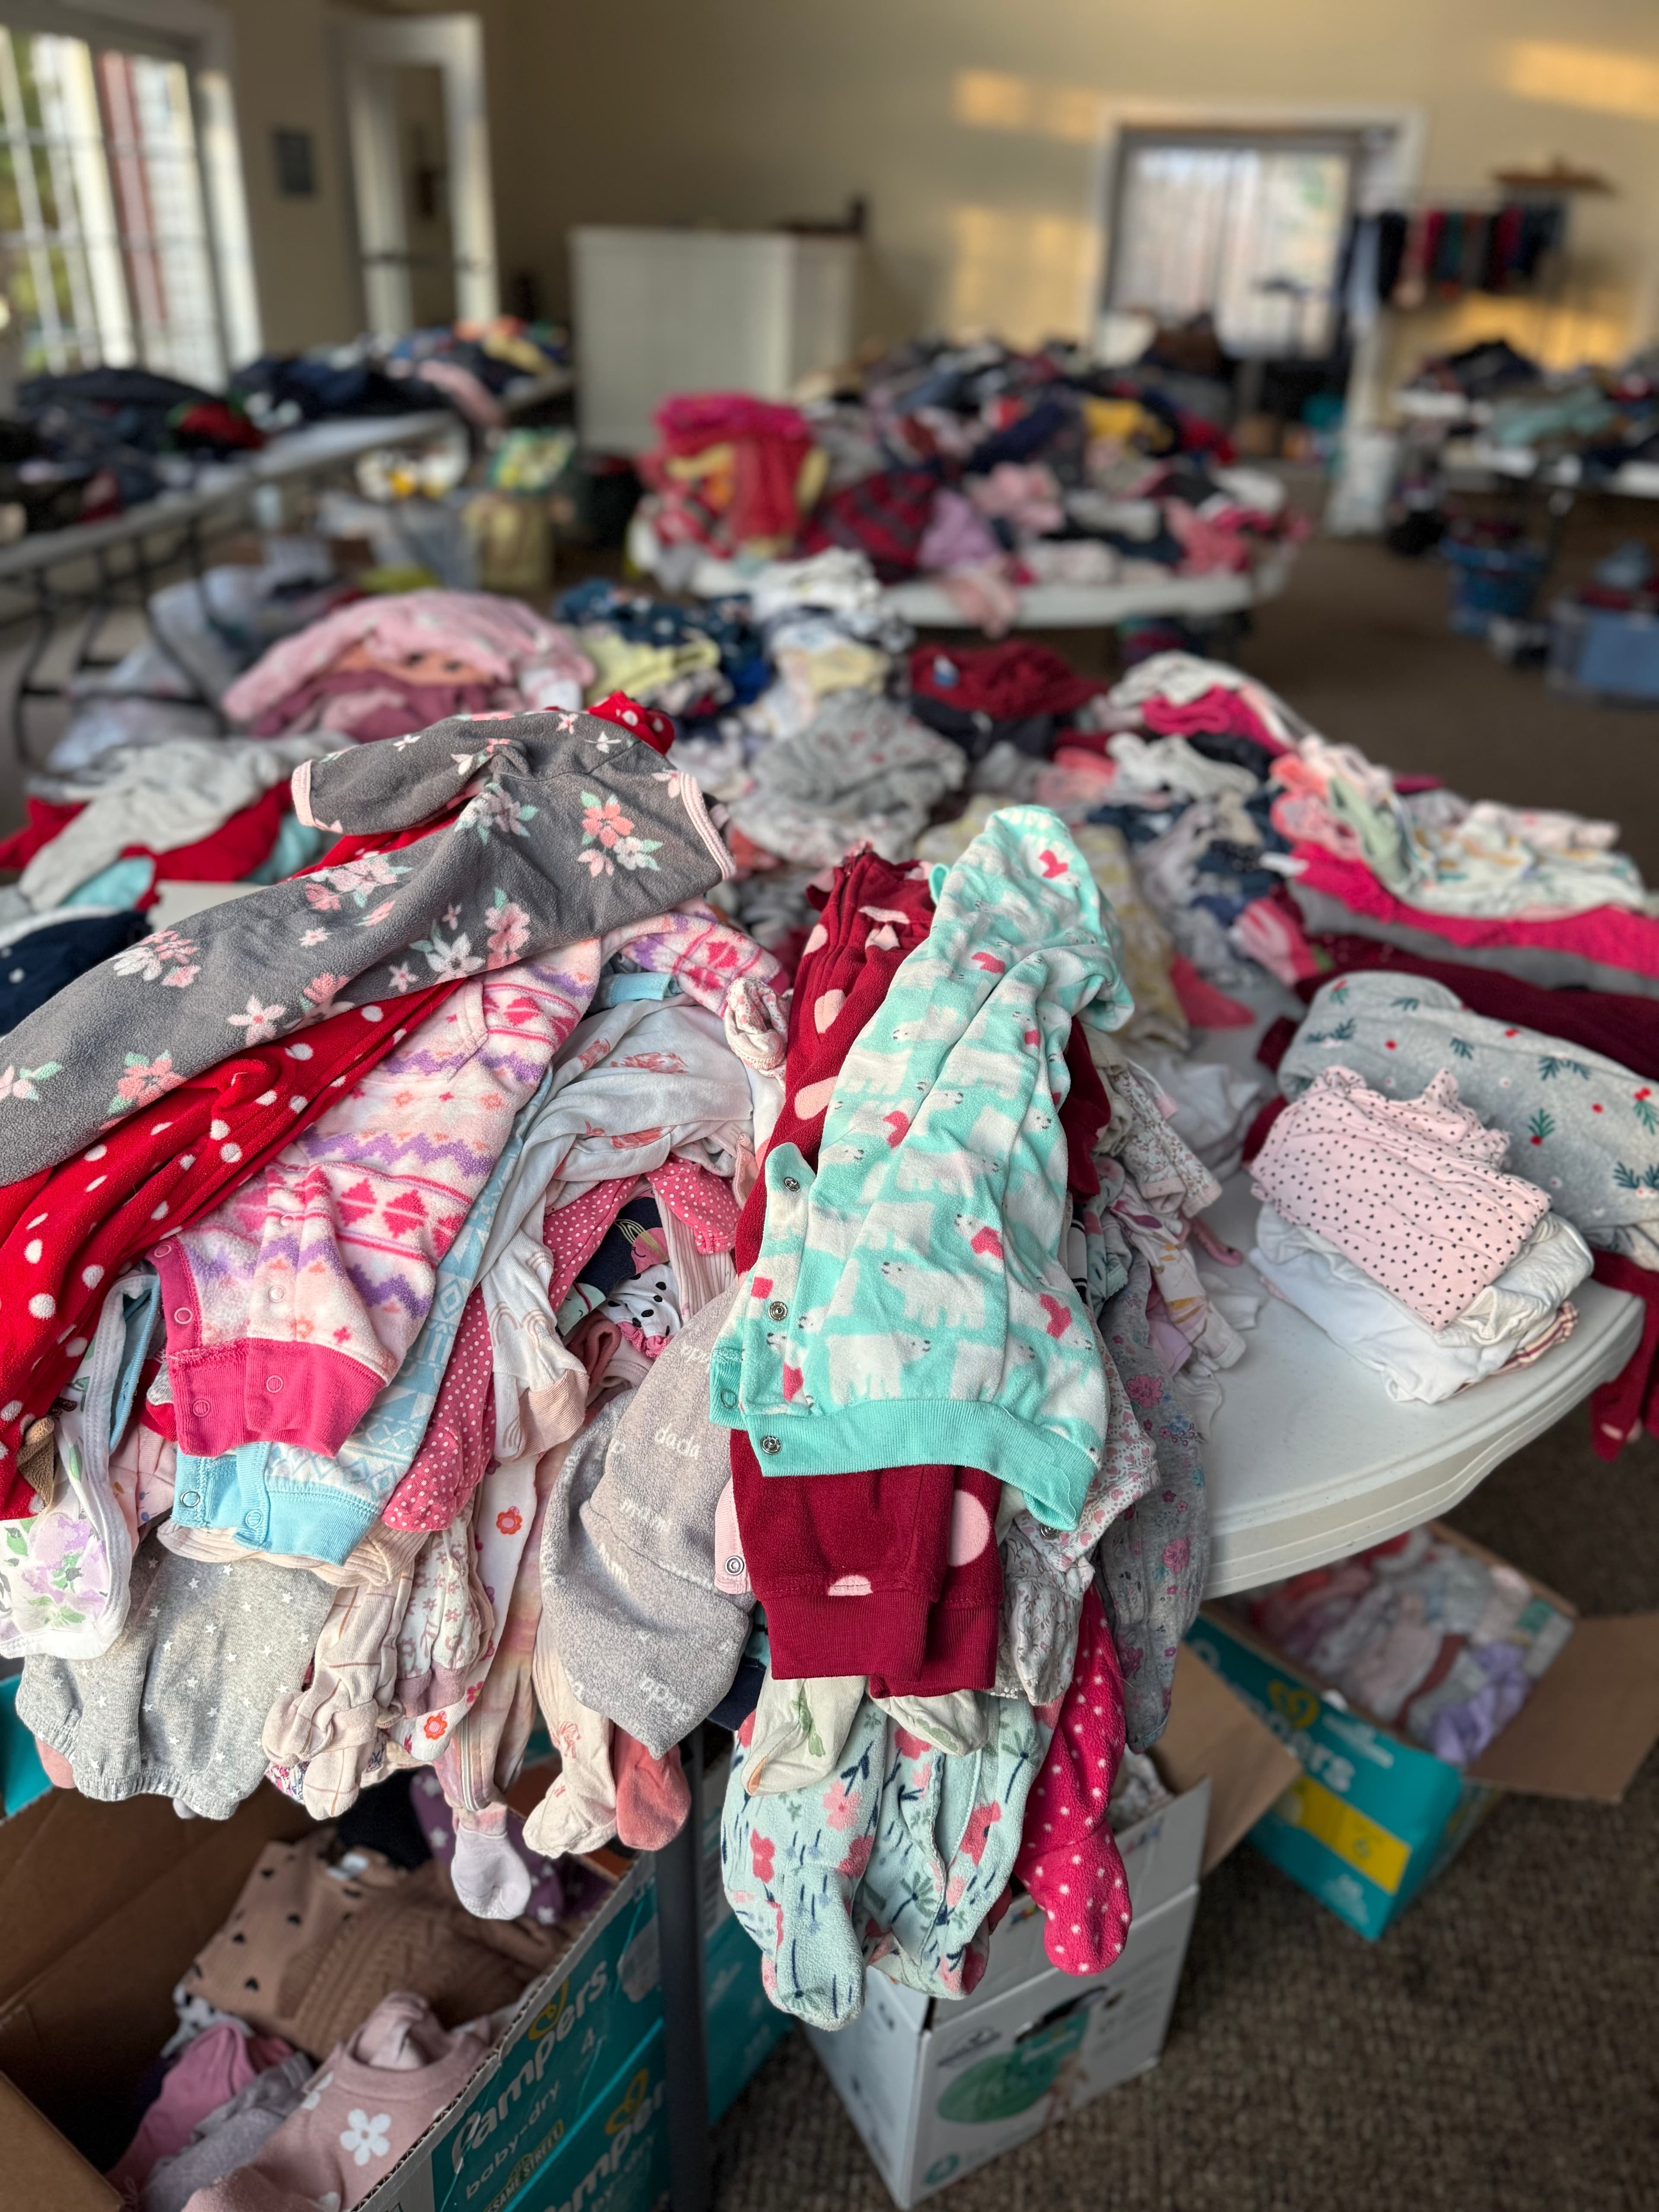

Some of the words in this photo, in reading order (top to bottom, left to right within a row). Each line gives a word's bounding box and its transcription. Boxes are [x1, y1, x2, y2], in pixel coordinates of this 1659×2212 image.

[655, 1423, 700, 1460] dada
[452, 1960, 607, 2174] Pampers
[466, 2080, 559, 2200] baby-dry
